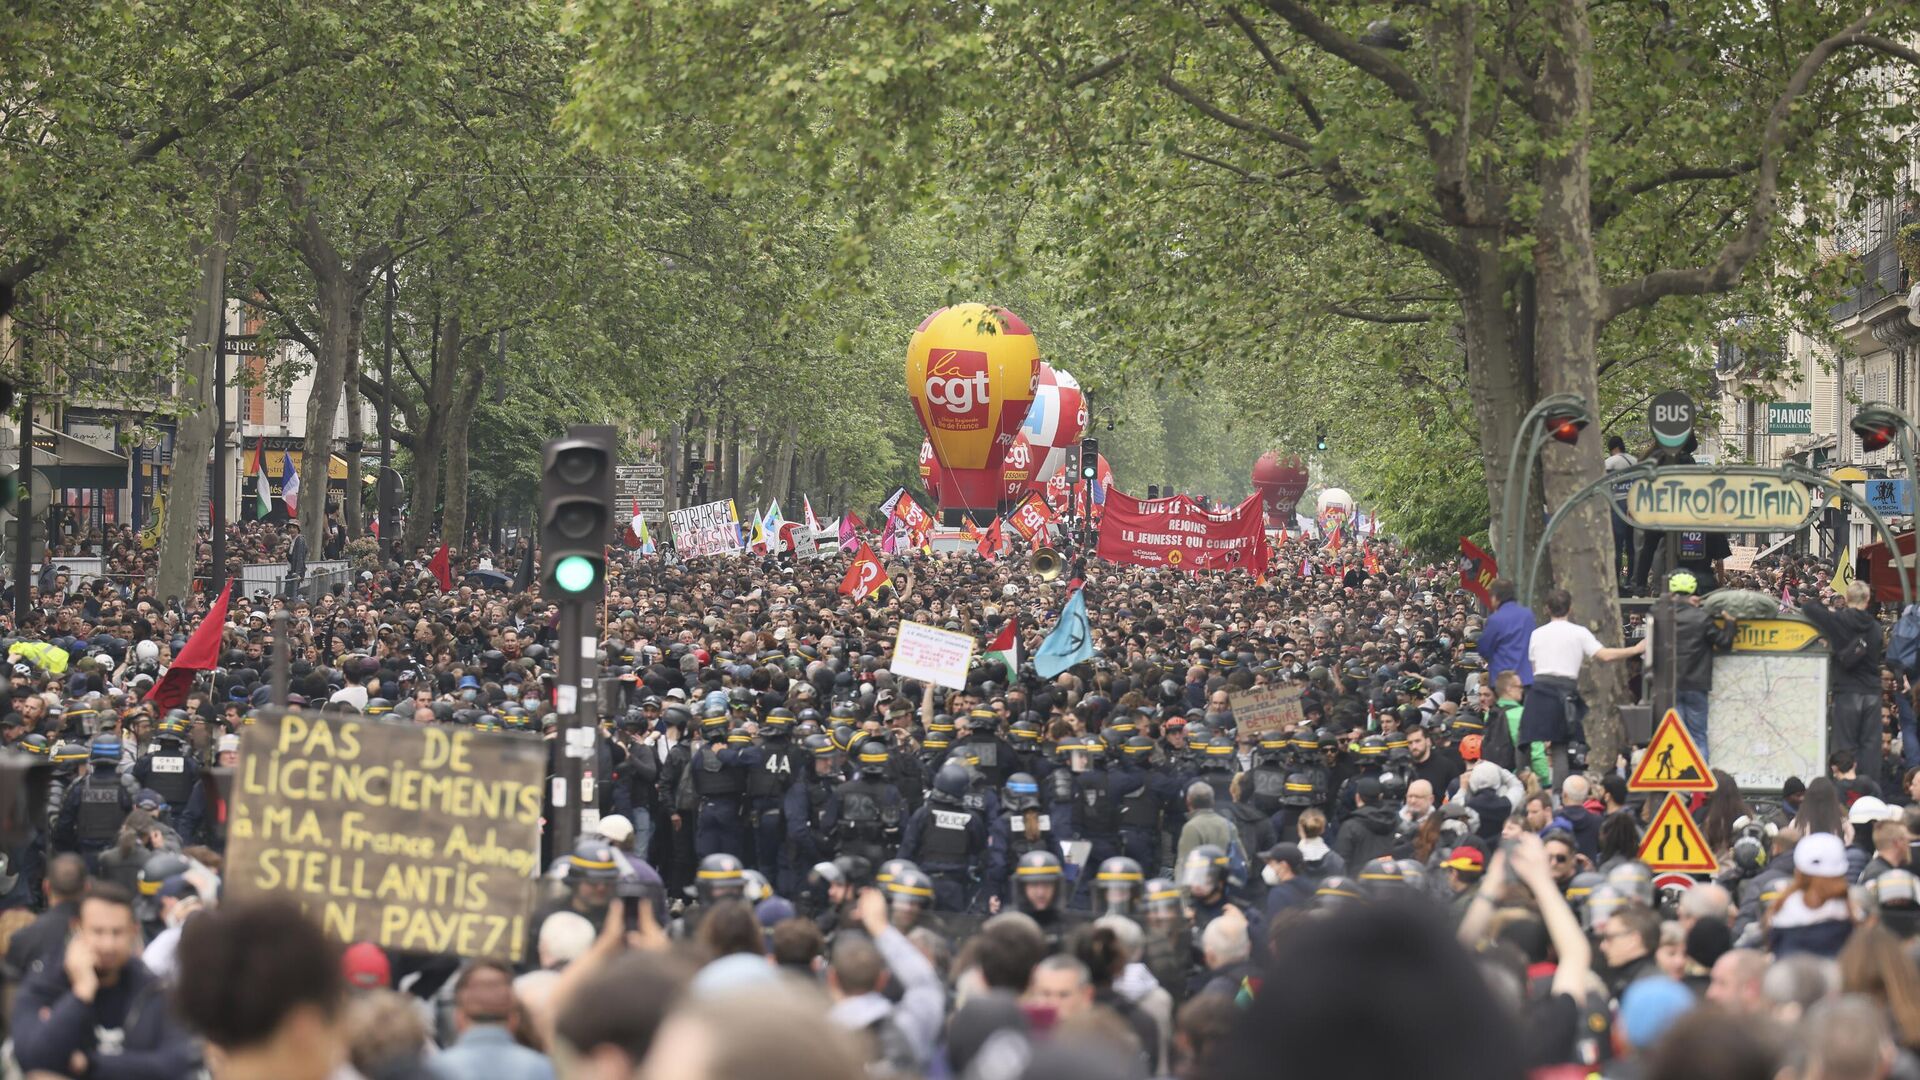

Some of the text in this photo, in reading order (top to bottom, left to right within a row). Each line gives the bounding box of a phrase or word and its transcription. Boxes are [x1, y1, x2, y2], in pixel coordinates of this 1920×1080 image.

[225, 339, 257, 354] ique
[925, 370, 990, 414] cgt
[1655, 405, 1689, 422] BUS
[1769, 408, 1811, 424] PIANOS
[1005, 442, 1031, 469] cgt
[1008, 482, 1022, 494] 91
[1635, 477, 1804, 520] METROPOLITAIN
[1022, 504, 1045, 531] cgt
[1138, 502, 1165, 515] VIVE
[1168, 501, 1181, 514] LE
[1169, 519, 1207, 535] REJOINS
[1122, 530, 1134, 542] LA
[1137, 532, 1183, 547] JEUNESSE
[1186, 536, 1203, 549] QUI
[1206, 537, 1248, 550] COMBAT
[279, 715, 475, 772] PAS DE
[765, 753, 792, 774] 4A
[244, 750, 542, 825] LICENCIEMENTS
[963, 794, 984, 809] RS
[341, 810, 435, 859] France
[255, 848, 489, 911] STELLANTIS
